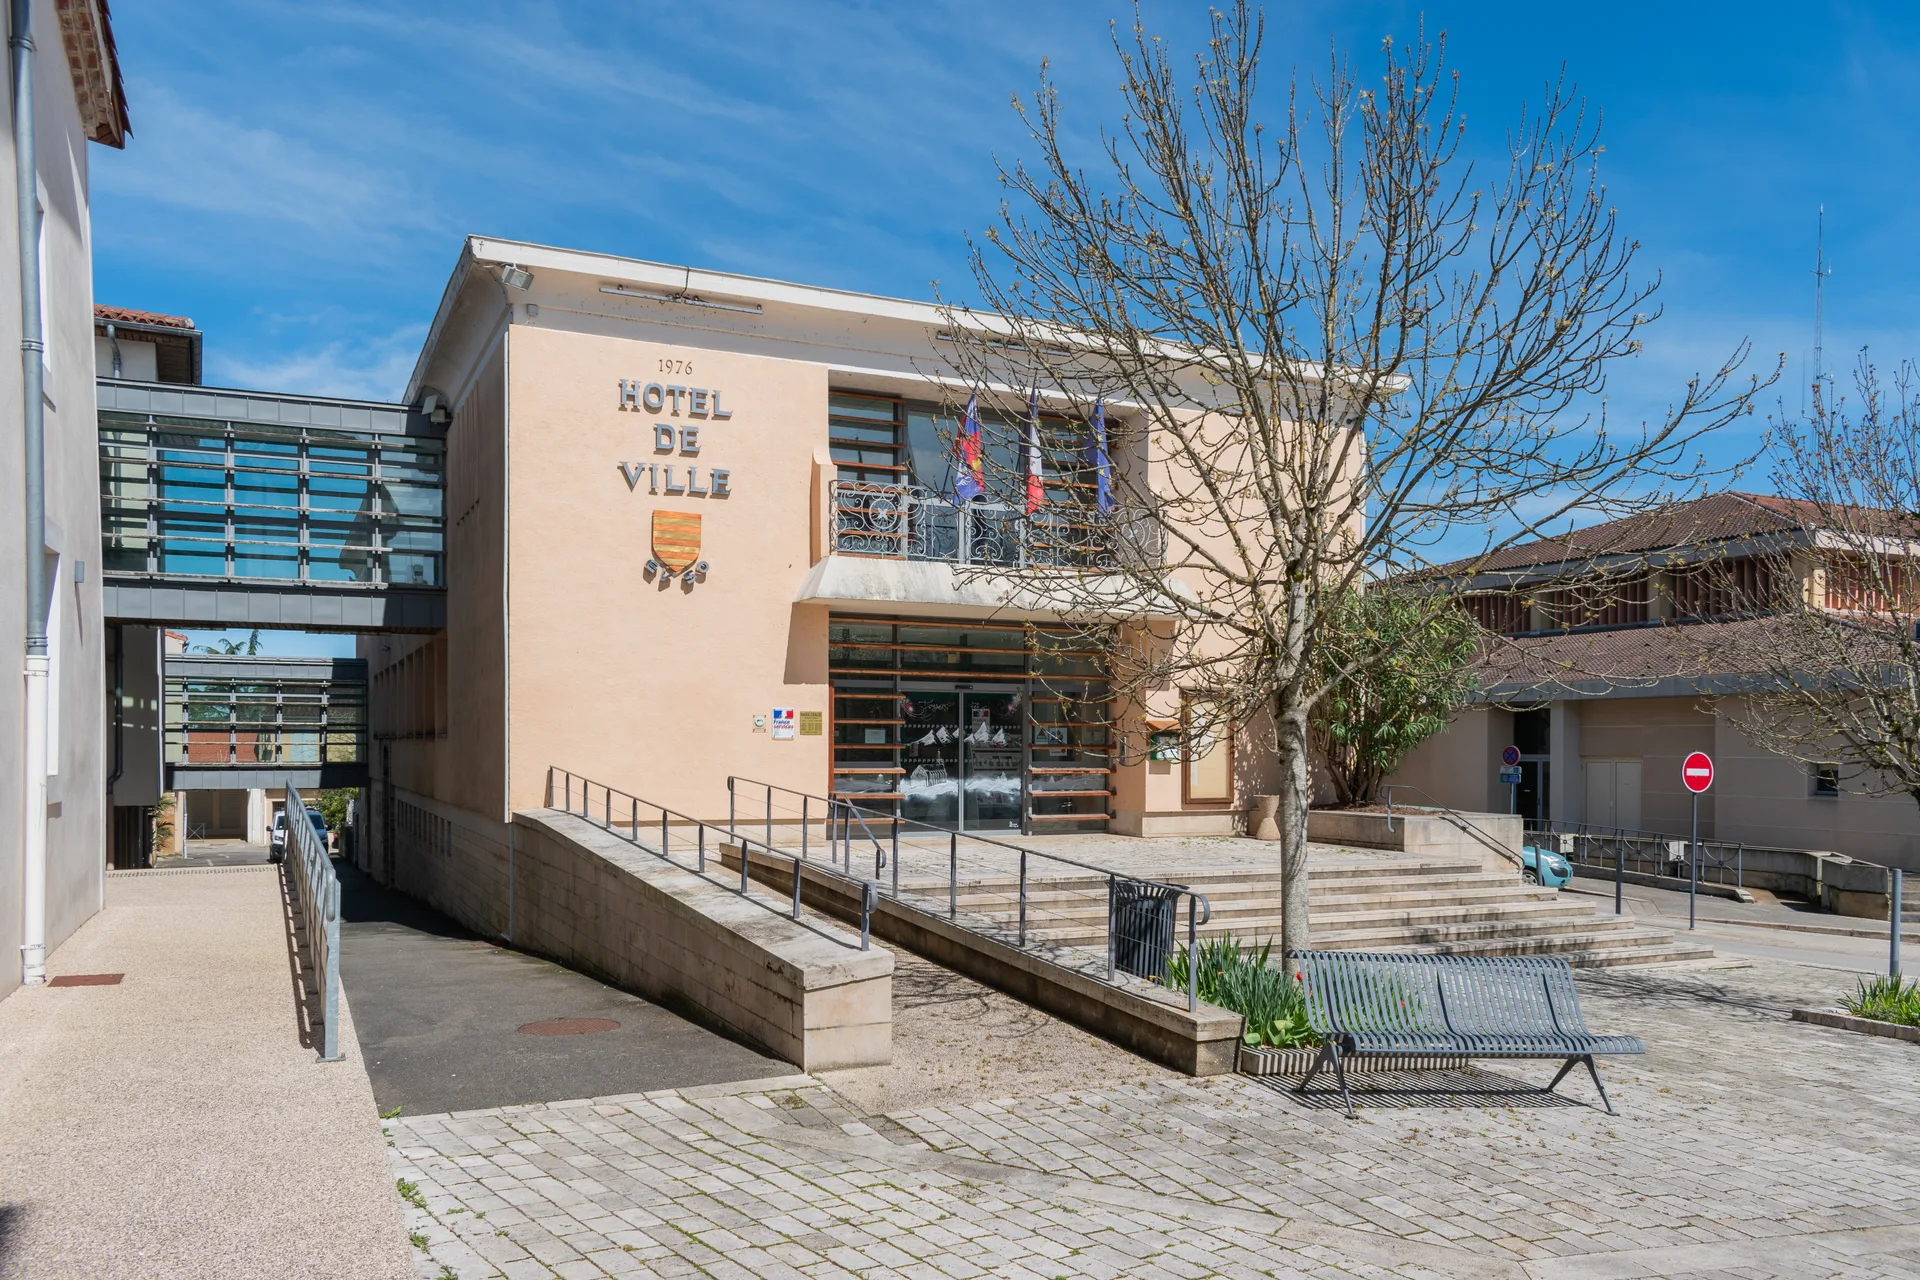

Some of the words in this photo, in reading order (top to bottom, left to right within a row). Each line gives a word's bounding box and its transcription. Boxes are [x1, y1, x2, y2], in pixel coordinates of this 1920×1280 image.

[658, 358, 693, 376] 1976
[619, 378, 733, 418] HOTEL
[653, 423, 701, 453] DE
[618, 460, 732, 495] VILLE
